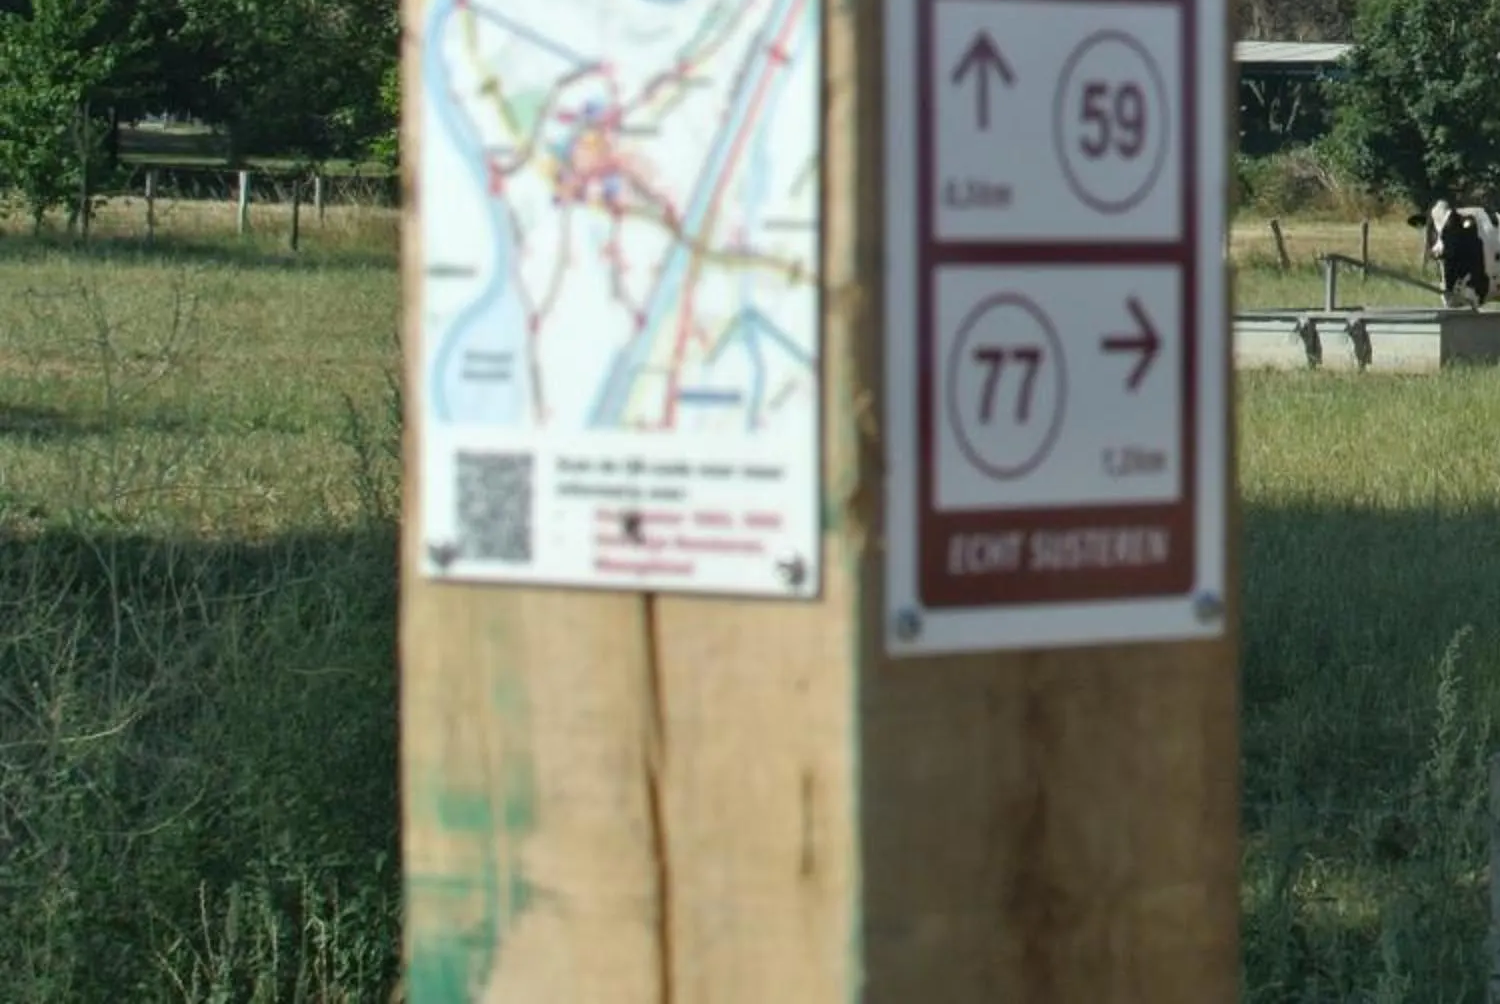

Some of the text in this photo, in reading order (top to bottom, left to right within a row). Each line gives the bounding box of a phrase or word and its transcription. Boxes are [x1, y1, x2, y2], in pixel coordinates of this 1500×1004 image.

[1079, 82, 1147, 160] 59
[972, 344, 1042, 425] 77
[948, 524, 1170, 575] ECHT SUSTEREN
